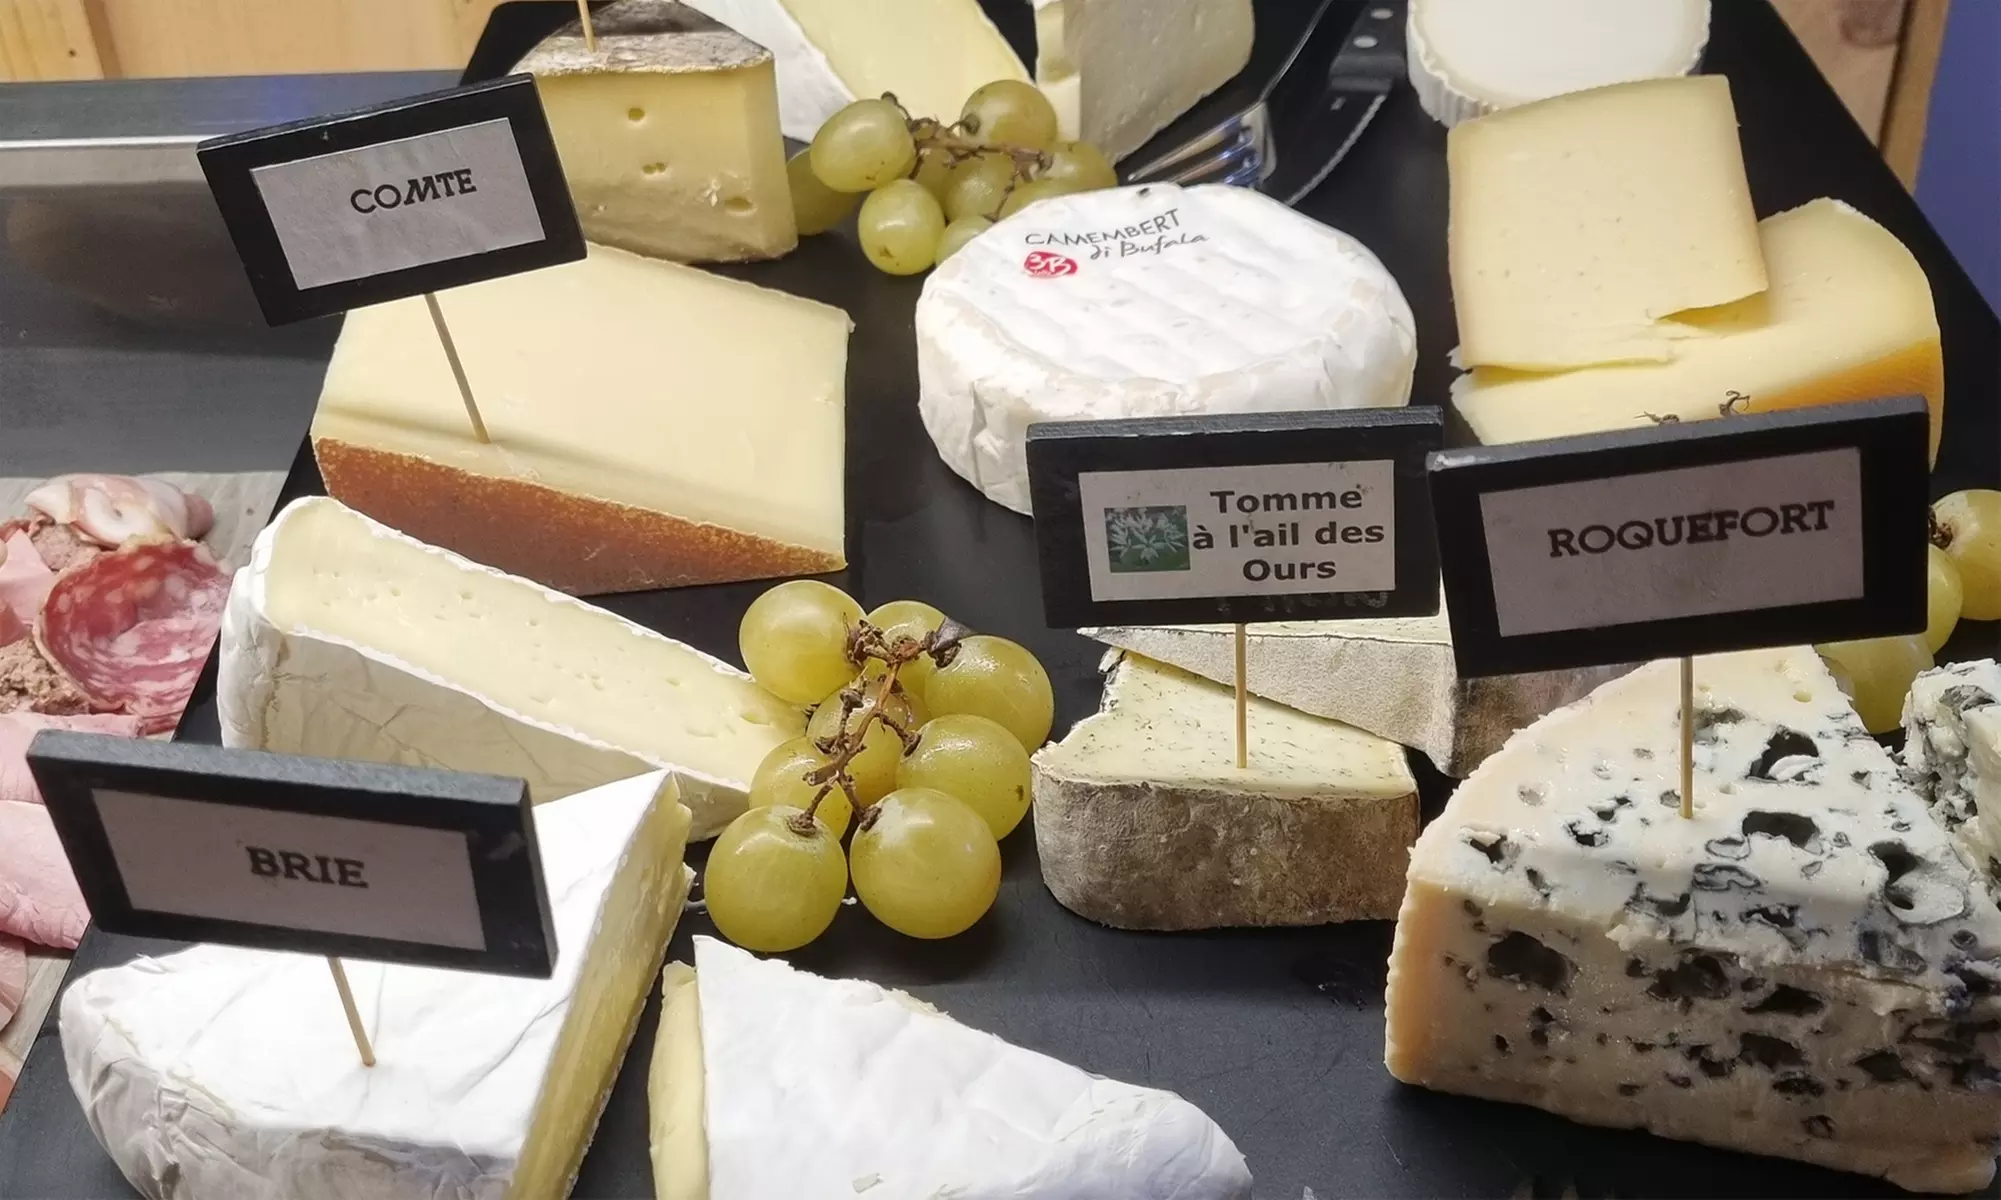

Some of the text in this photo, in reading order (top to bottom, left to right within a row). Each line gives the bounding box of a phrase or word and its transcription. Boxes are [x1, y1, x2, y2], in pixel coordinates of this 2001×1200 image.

[350, 168, 477, 214] COMTE
[1025, 208, 1181, 247] CAMEMBERT
[1090, 232, 1210, 260] di Bufala
[1209, 489, 1363, 514] Tomme
[1192, 521, 1385, 550] à l'ail des
[1547, 499, 1835, 558] ROQUEFORT
[1242, 559, 1337, 582] Ours
[245, 846, 369, 889] BRIE
